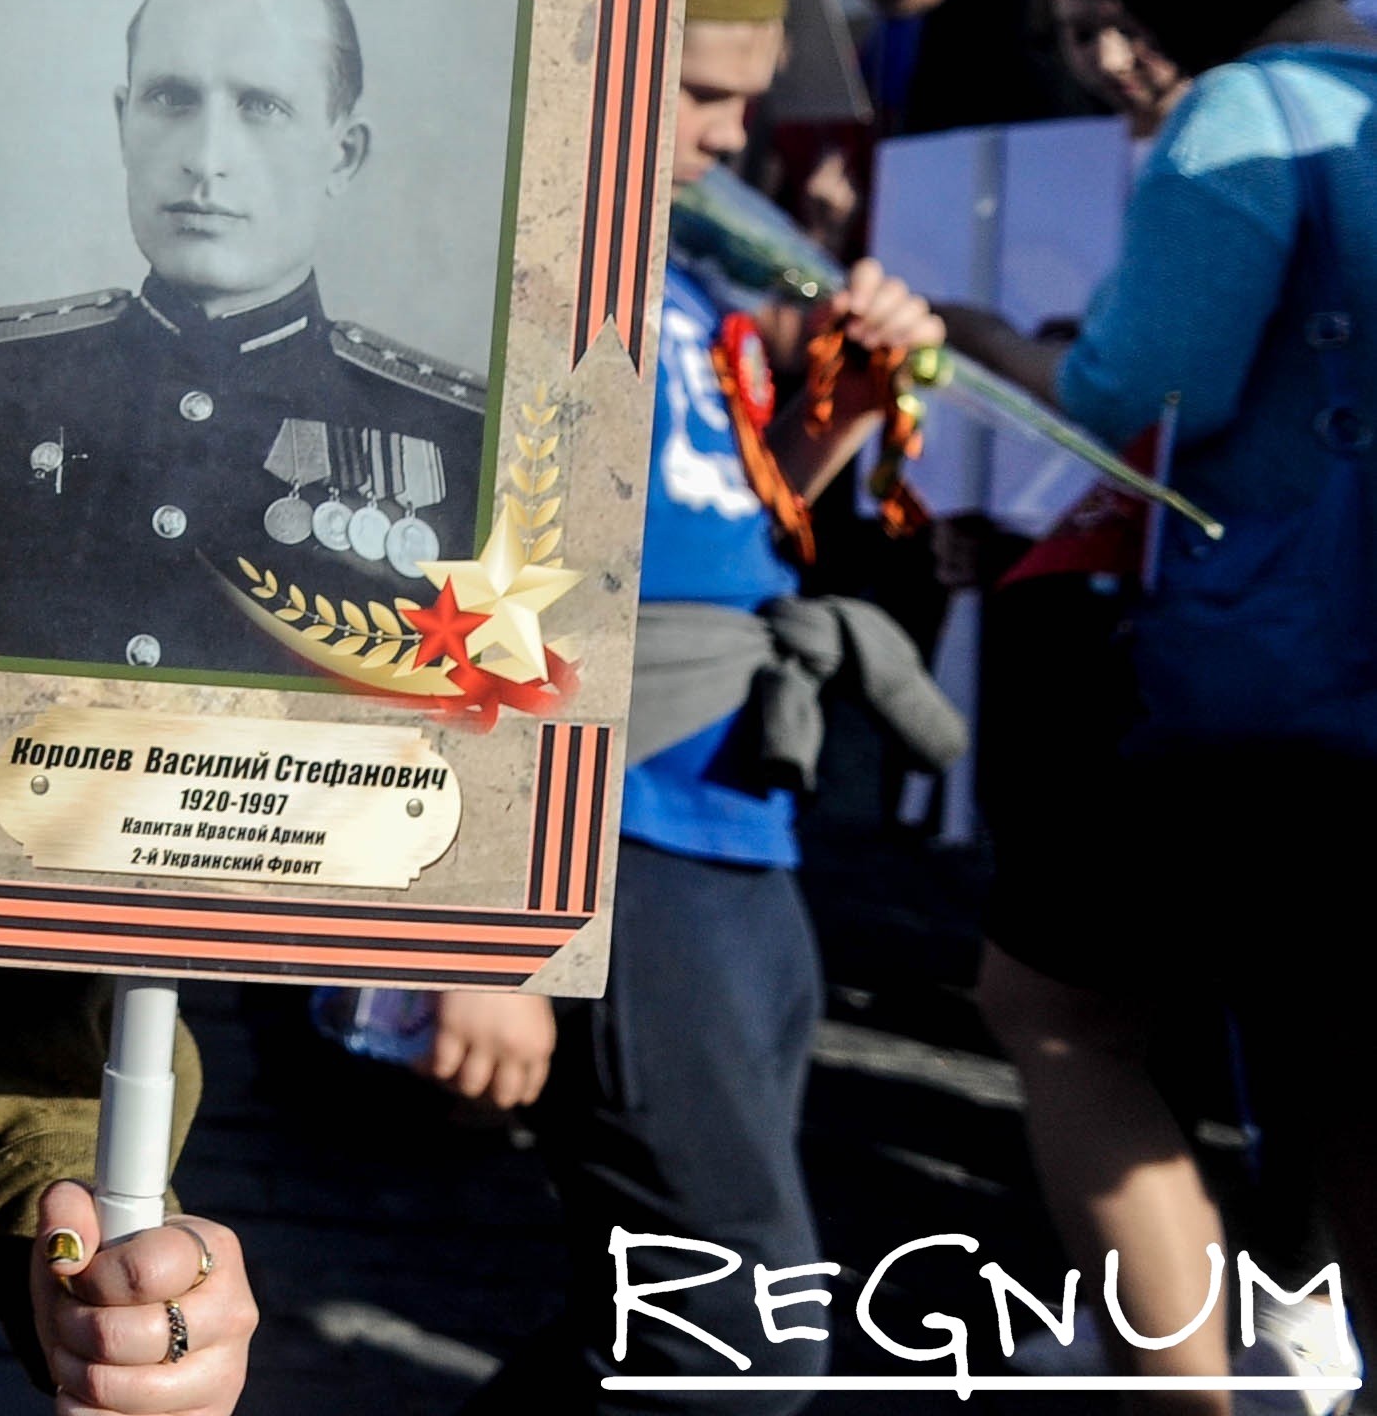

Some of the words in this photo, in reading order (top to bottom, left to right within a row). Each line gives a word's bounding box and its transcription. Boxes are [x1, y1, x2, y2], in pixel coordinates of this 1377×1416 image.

[10, 736, 133, 772] Королев
[145, 746, 270, 780] Василий
[275, 753, 448, 791] Стефанович
[179, 788, 289, 816] 1920-1997
[121, 816, 192, 838] Капитан
[196, 821, 268, 843] Красной
[270, 827, 327, 846] Армии
[131, 846, 158, 867] 2-й
[161, 848, 265, 872] Украинский
[267, 854, 323, 875] Фронт
